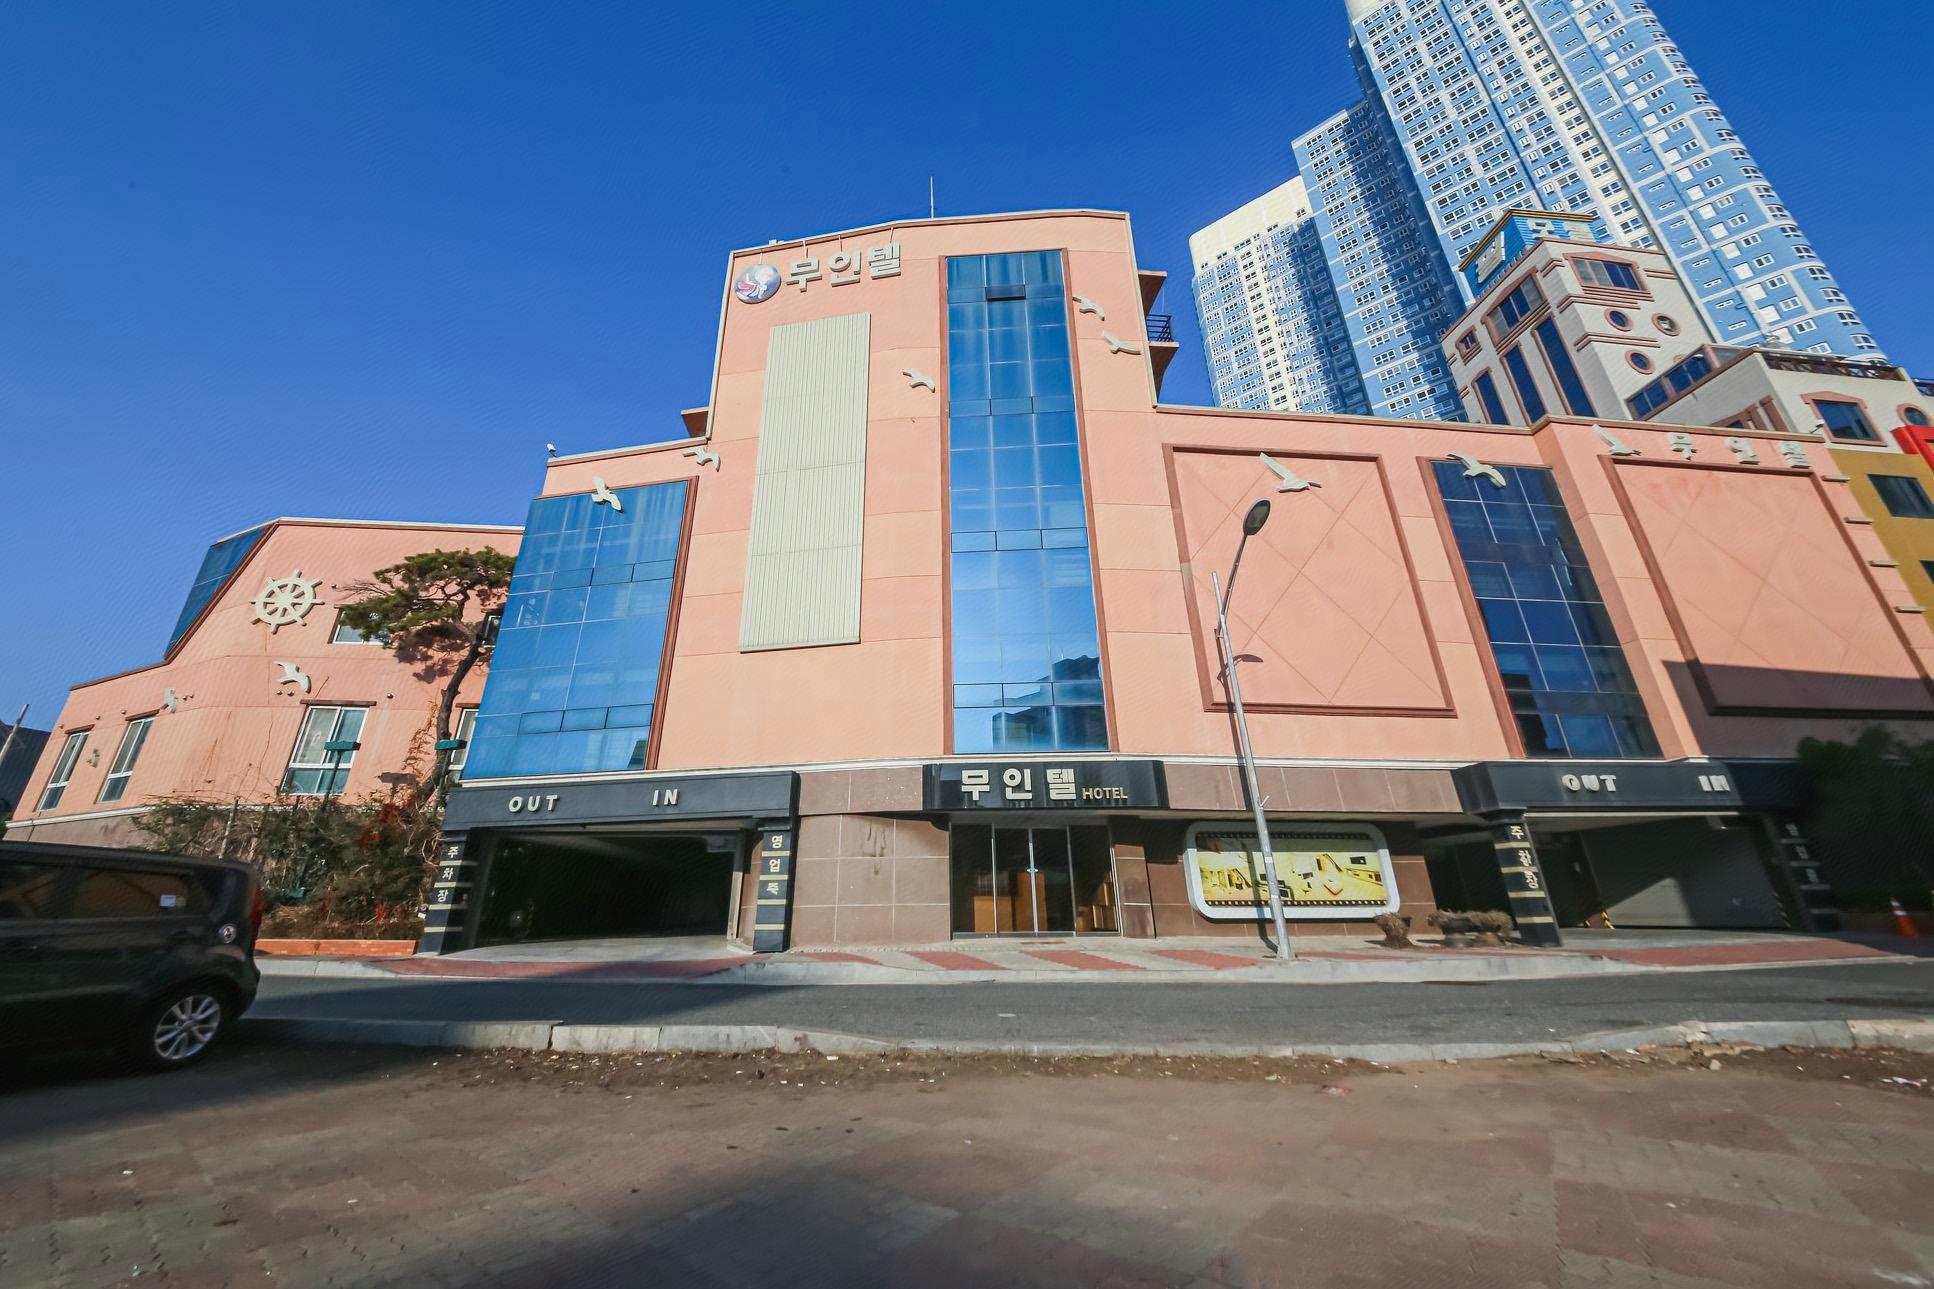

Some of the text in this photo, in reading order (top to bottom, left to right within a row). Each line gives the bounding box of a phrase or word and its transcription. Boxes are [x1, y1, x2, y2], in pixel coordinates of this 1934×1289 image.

[786, 242, 901, 292] 무인텔
[961, 768, 1128, 801] 무인텔 HOTEL
[1561, 773, 1617, 792] OUT
[1698, 774, 1731, 792] IN
[508, 794, 560, 812] OUT
[652, 788, 679, 806] IN
[437, 846, 459, 902] 주차장
